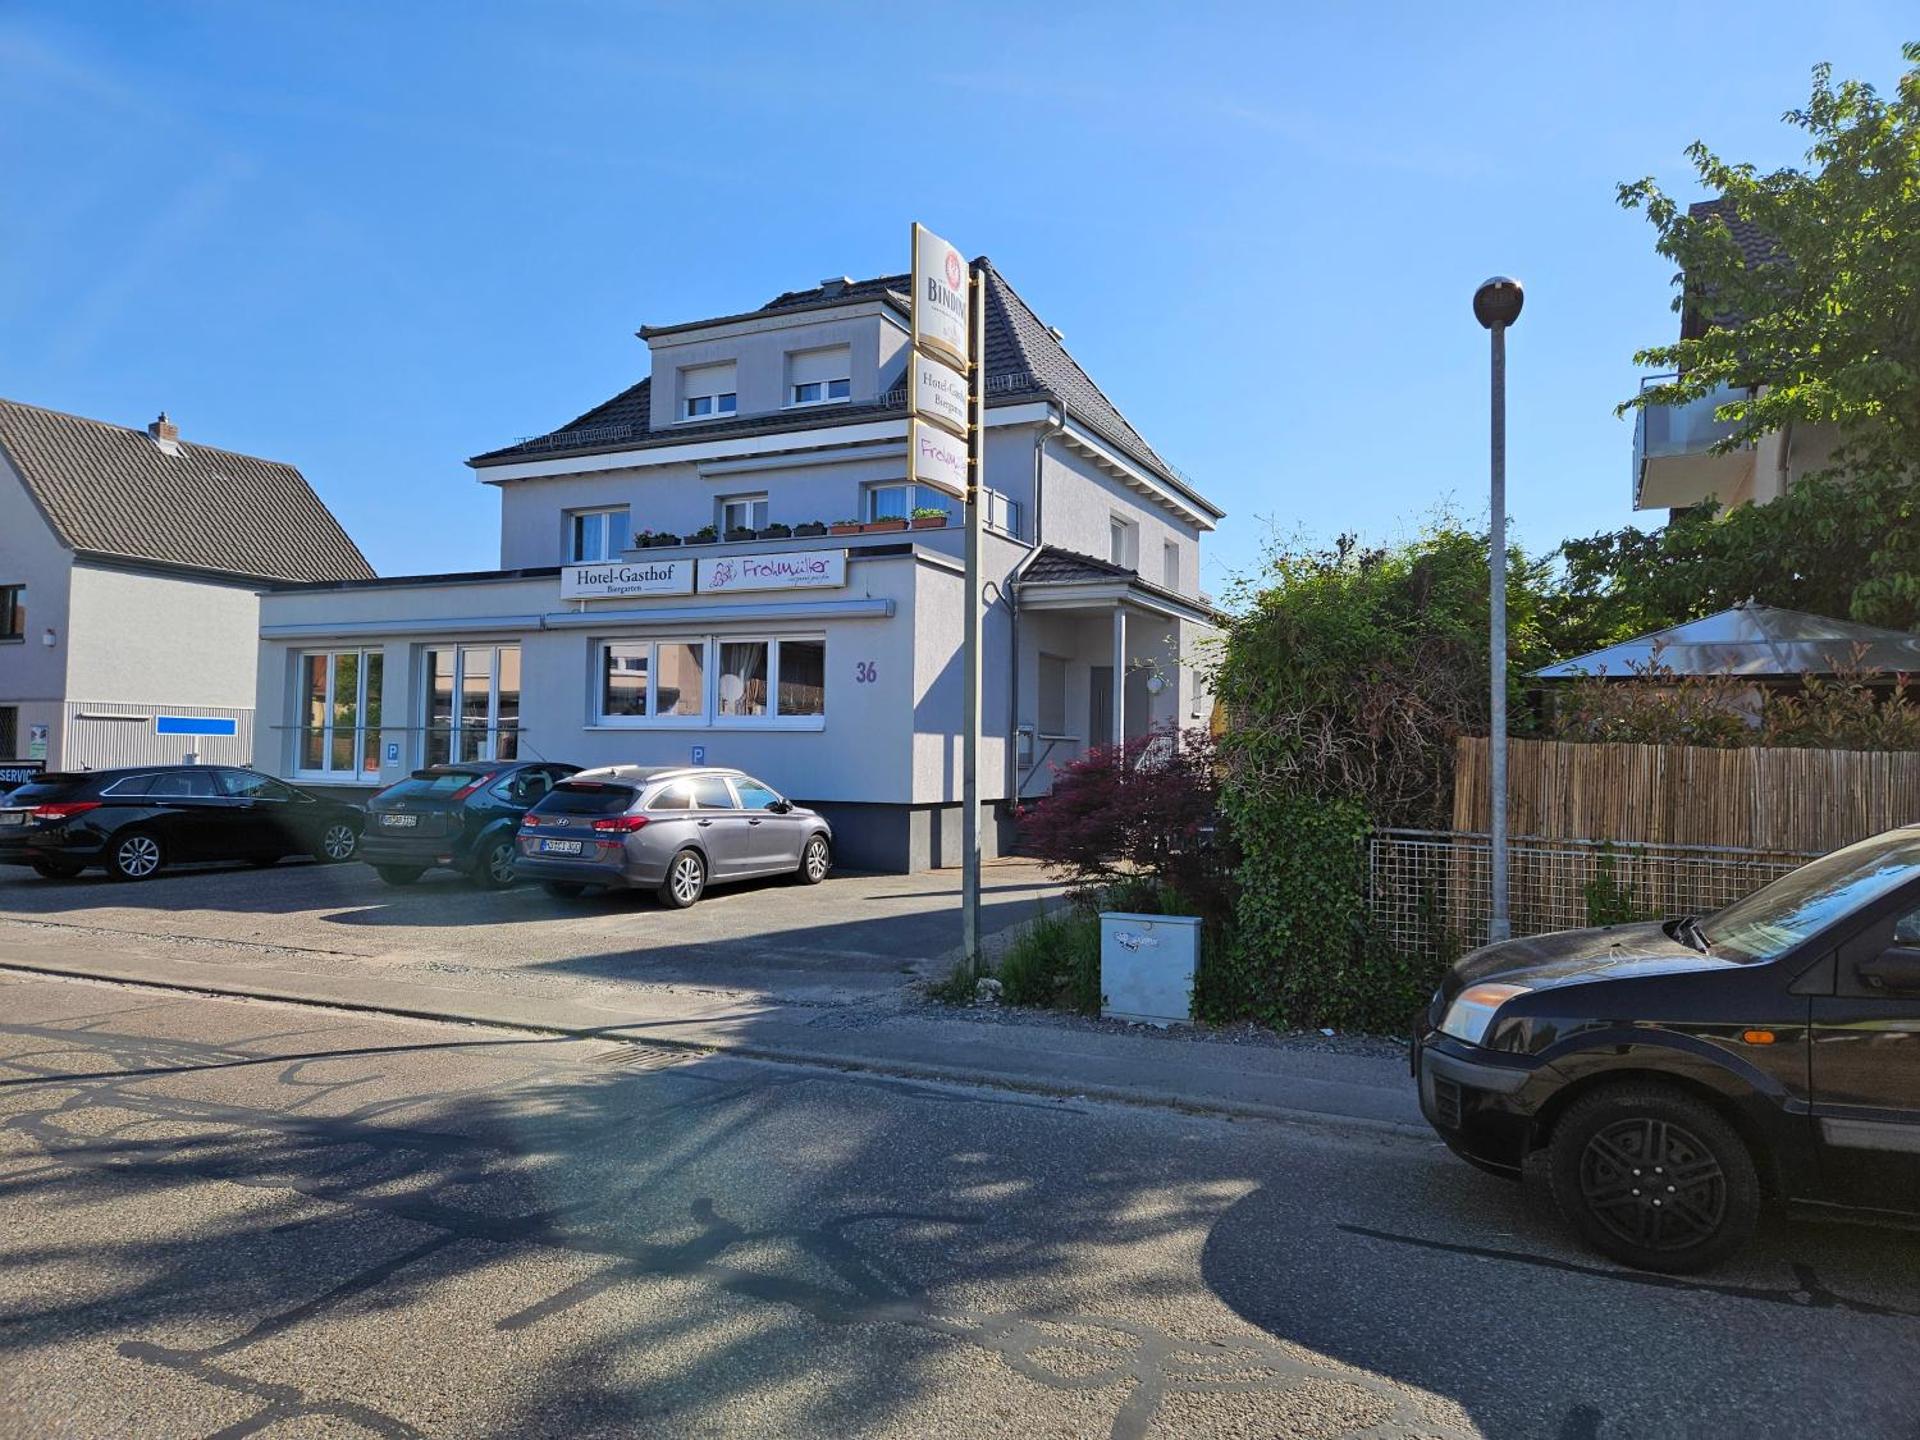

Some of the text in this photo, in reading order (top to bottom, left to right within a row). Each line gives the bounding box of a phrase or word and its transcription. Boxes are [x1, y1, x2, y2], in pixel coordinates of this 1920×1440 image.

[577, 564, 675, 585] Hotel-Gasthof
[607, 585, 642, 594] Biergarten
[856, 661, 877, 683] 36
[0, 768, 36, 784] SERVIC
